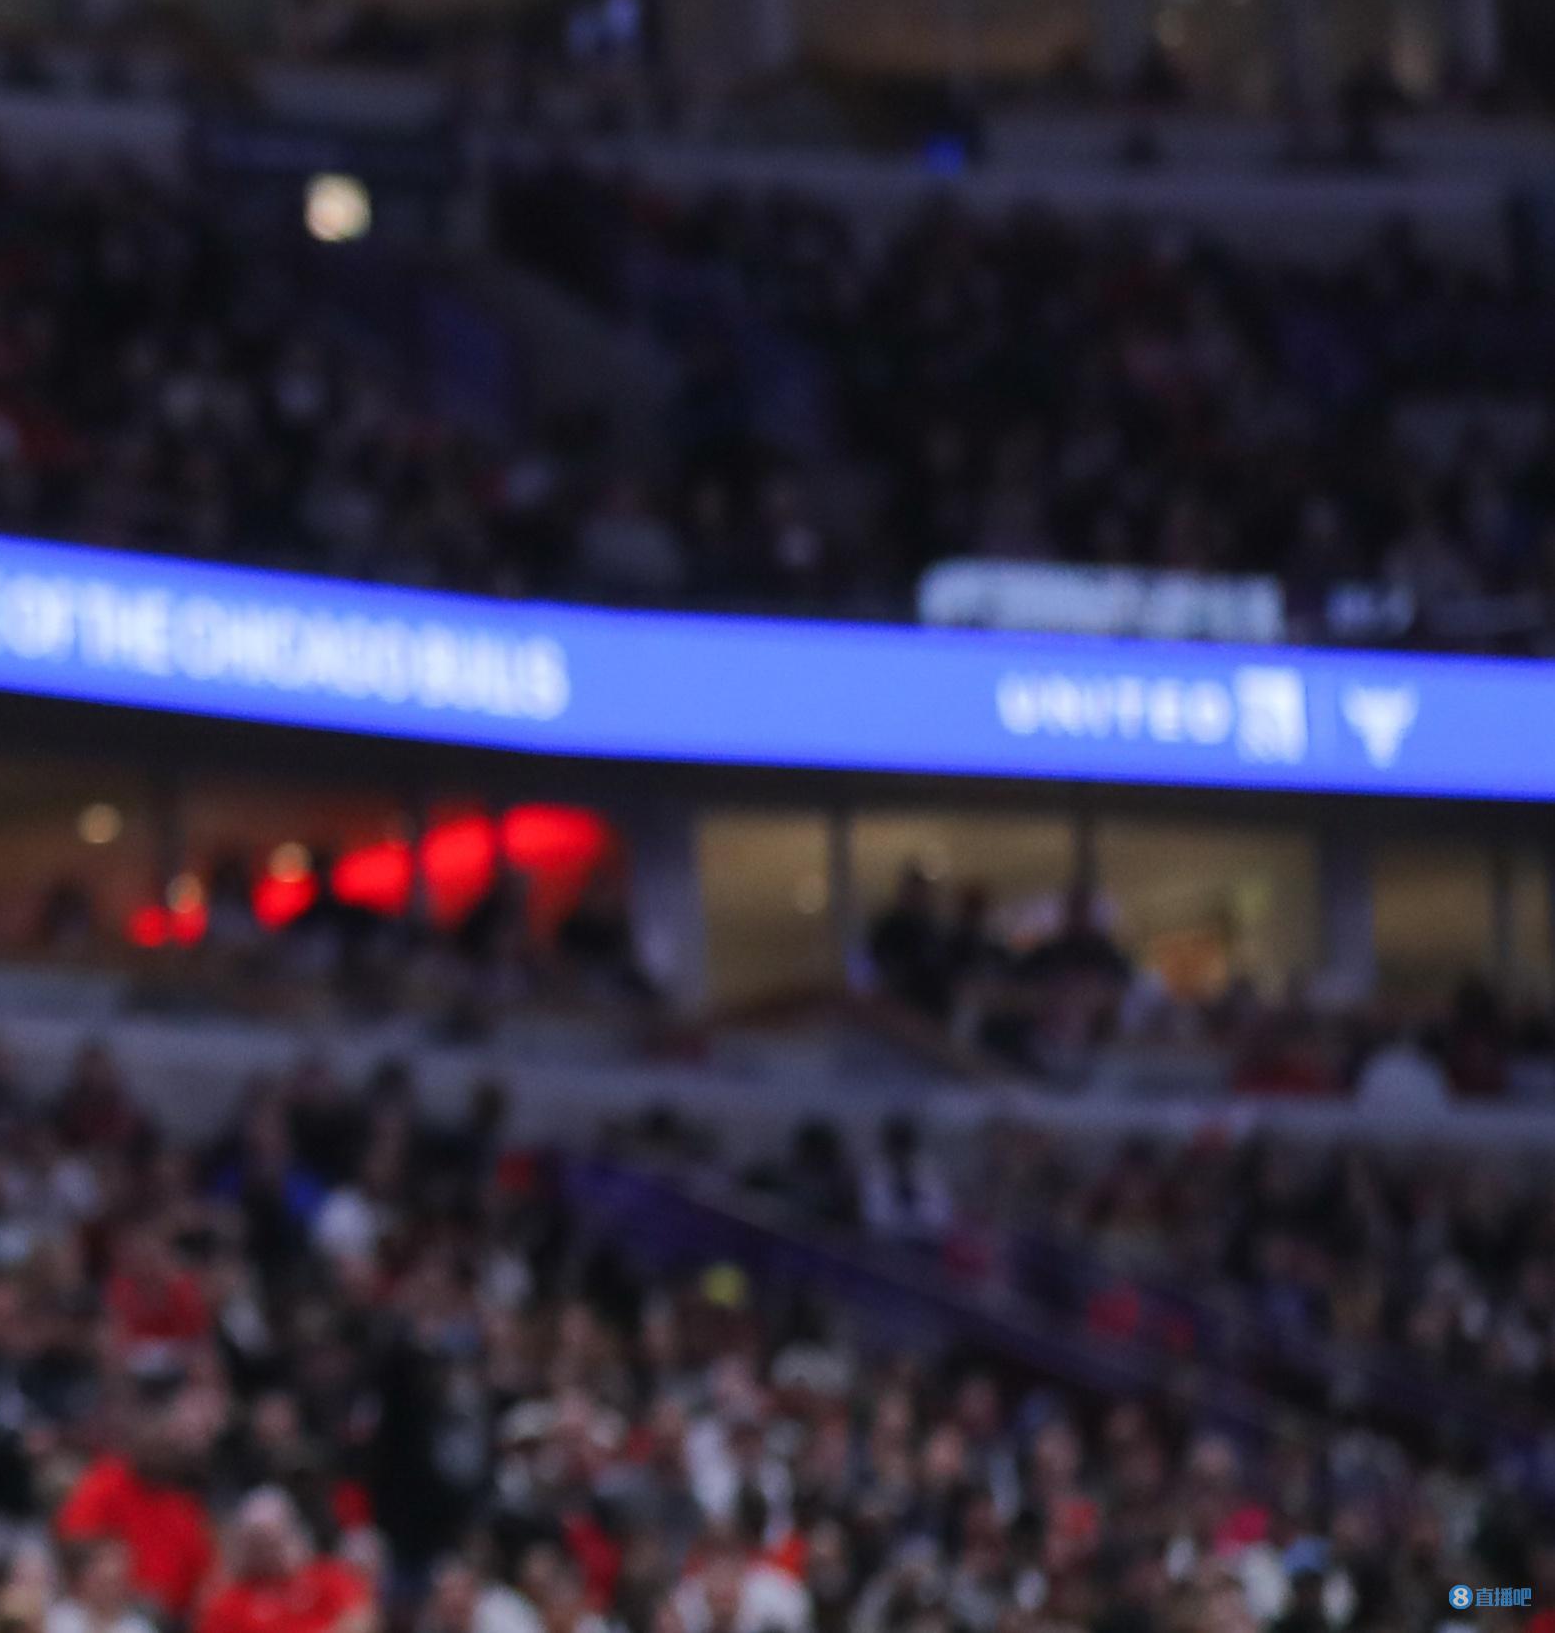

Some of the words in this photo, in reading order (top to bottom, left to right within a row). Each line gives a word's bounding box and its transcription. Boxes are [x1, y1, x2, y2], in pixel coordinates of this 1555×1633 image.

[78, 579, 175, 677] THE
[169, 592, 416, 703] CHICAGO
[411, 618, 570, 722] BULLS
[996, 672, 1231, 744] UNITED
